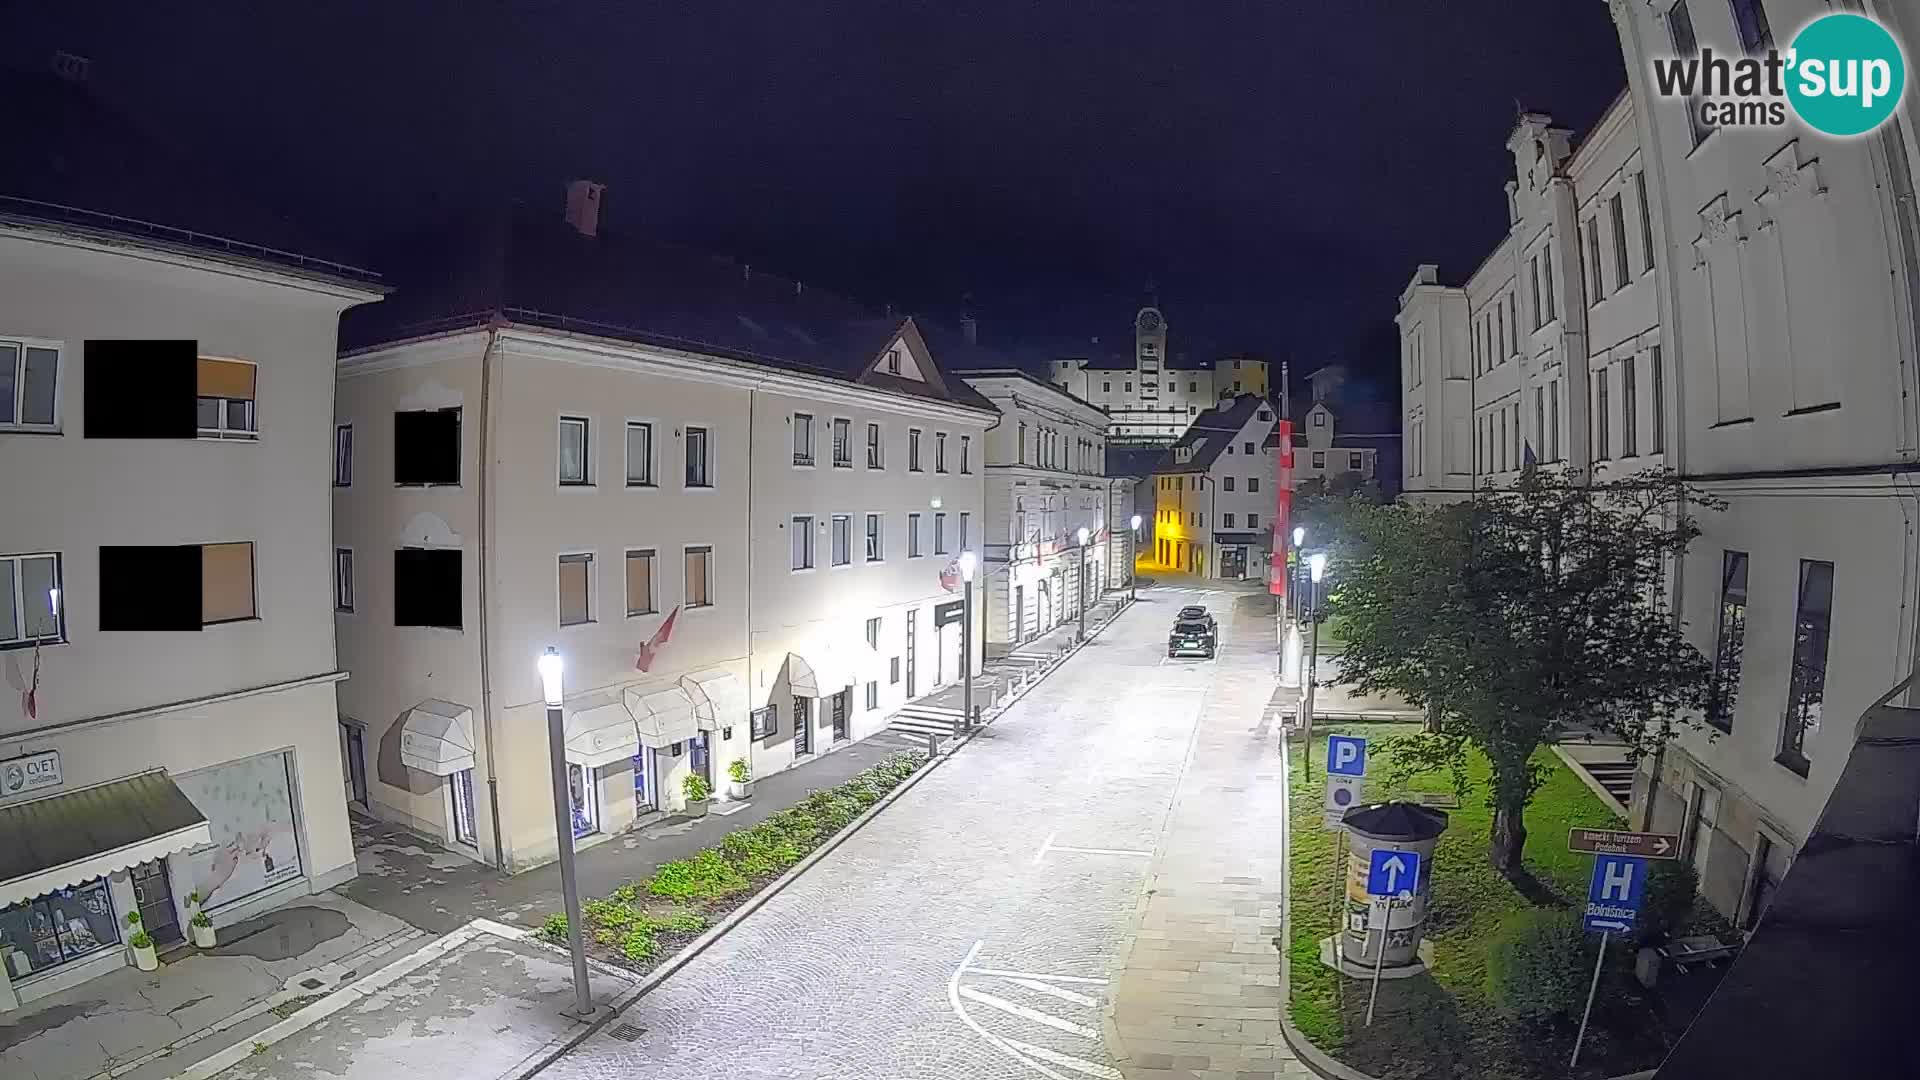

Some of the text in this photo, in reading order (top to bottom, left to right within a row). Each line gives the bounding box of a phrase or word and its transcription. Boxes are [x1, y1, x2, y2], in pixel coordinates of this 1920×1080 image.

[27, 758, 55, 775] CVET
[1336, 741, 1357, 769] P
[1602, 862, 1633, 901] H
[1587, 902, 1637, 920] Bolnišnica
